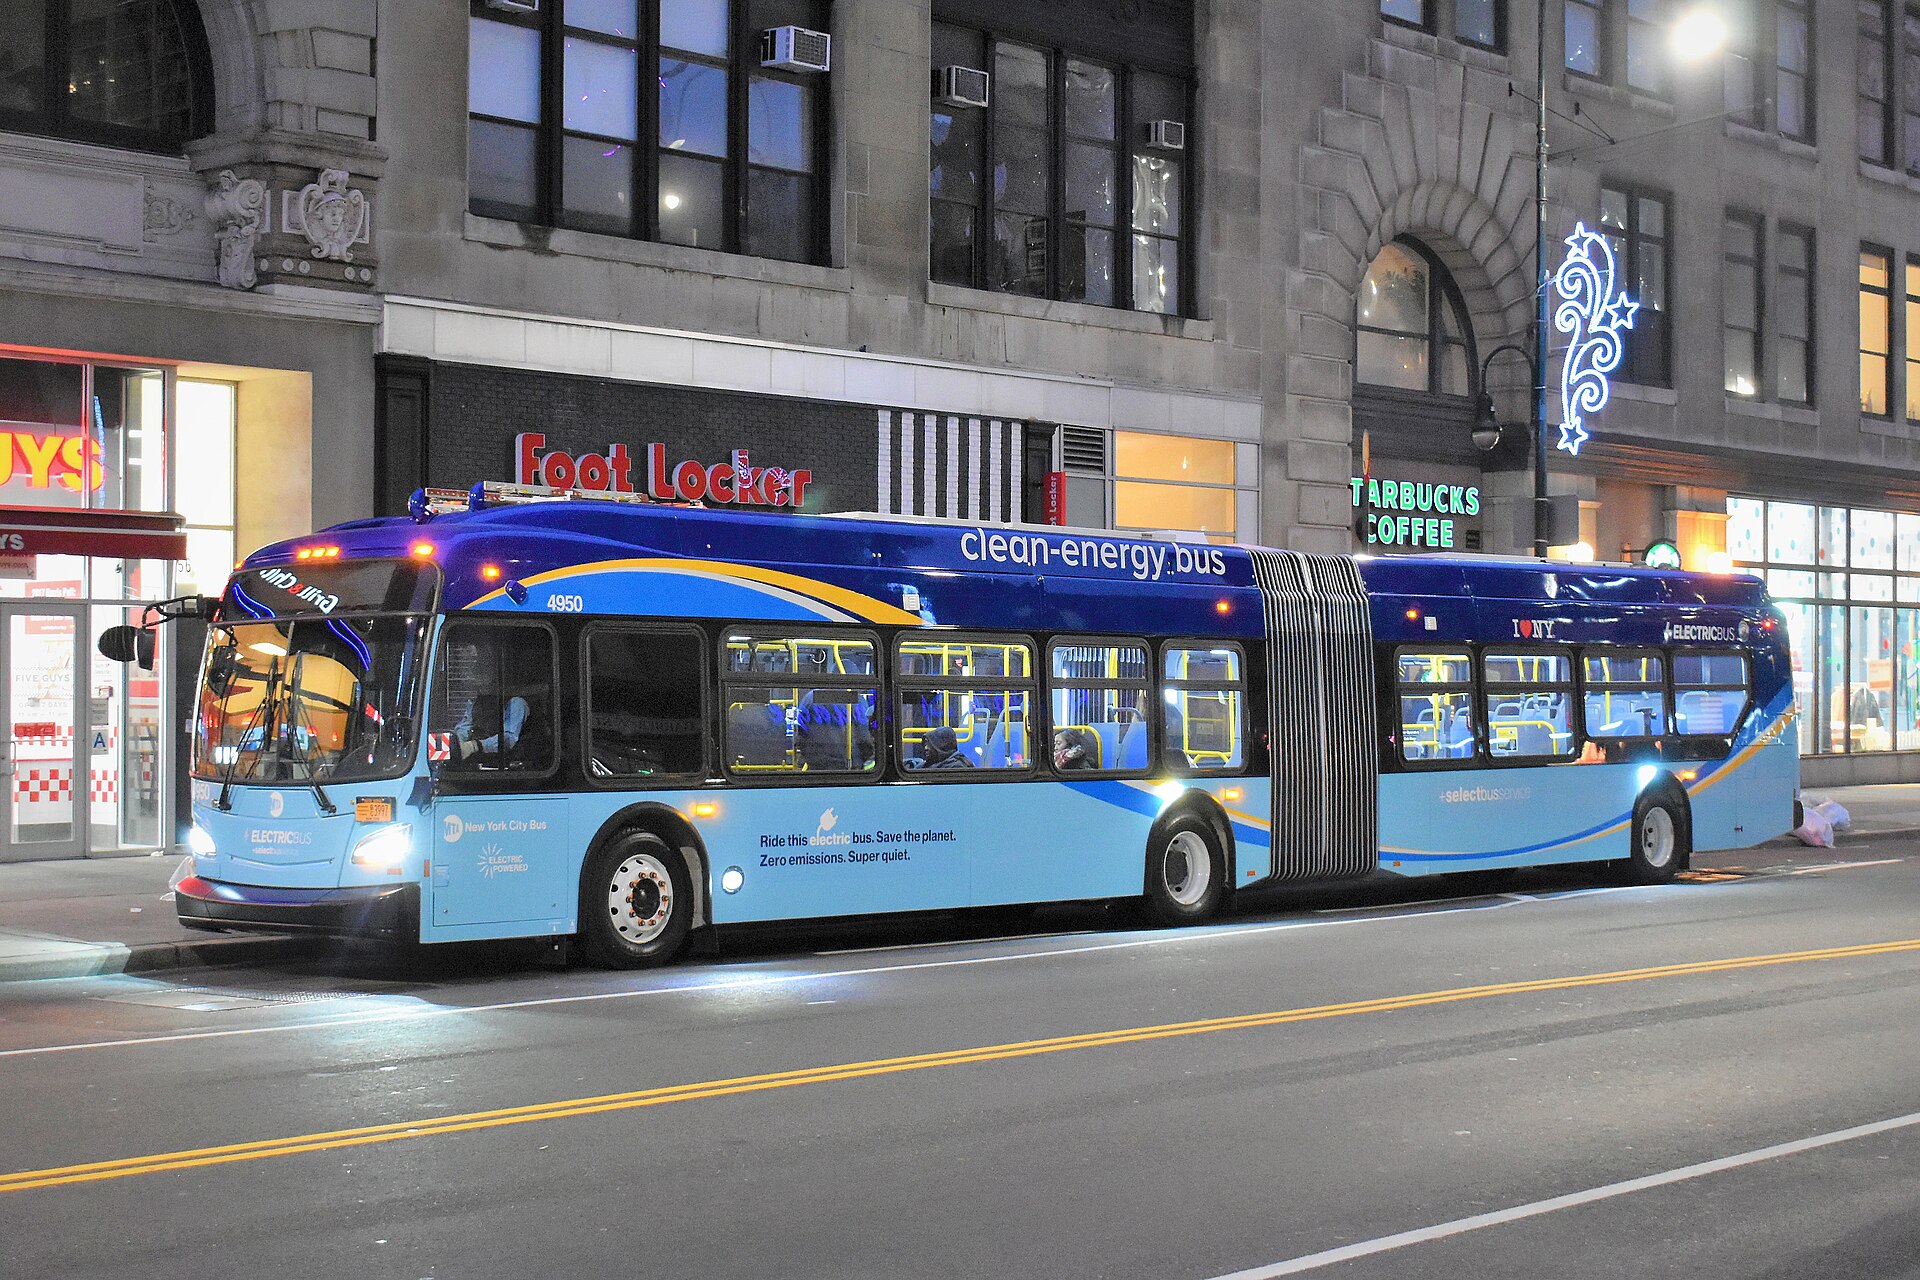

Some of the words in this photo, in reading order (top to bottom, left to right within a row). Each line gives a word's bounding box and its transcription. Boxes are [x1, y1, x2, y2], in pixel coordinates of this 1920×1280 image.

[515, 432, 634, 493] Foot
[647, 442, 812, 508] Locker
[1049, 475, 1057, 513] Locker
[1350, 477, 1480, 516] TARBUCKS
[1367, 513, 1454, 548] COFFEE
[960, 527, 1166, 581] clean-energy
[1173, 542, 1227, 576] bus
[547, 594, 584, 612] 4950
[1512, 618, 1521, 638] I
[1531, 619, 1555, 639] NY
[15, 674, 39, 682] FIVE
[42, 674, 71, 682] GUYS
[93, 732, 106, 748] A
[465, 822, 485, 832] New
[487, 821, 507, 832] York
[509, 820, 528, 833] City
[530, 819, 547, 830] Bus
[760, 834, 786, 848] Ride
[788, 834, 808, 847] this
[809, 832, 850, 847] electric
[852, 831, 874, 844] bus.
[876, 830, 902, 843] Save
[904, 829, 920, 843] the
[922, 829, 956, 845] planet.
[488, 855, 523, 864] ELECTRIC
[760, 854, 787, 867] Zero
[789, 851, 846, 866] emissions.
[848, 850, 880, 866] Super
[881, 849, 911, 863] quiet.
[493, 864, 529, 873] POWERED
